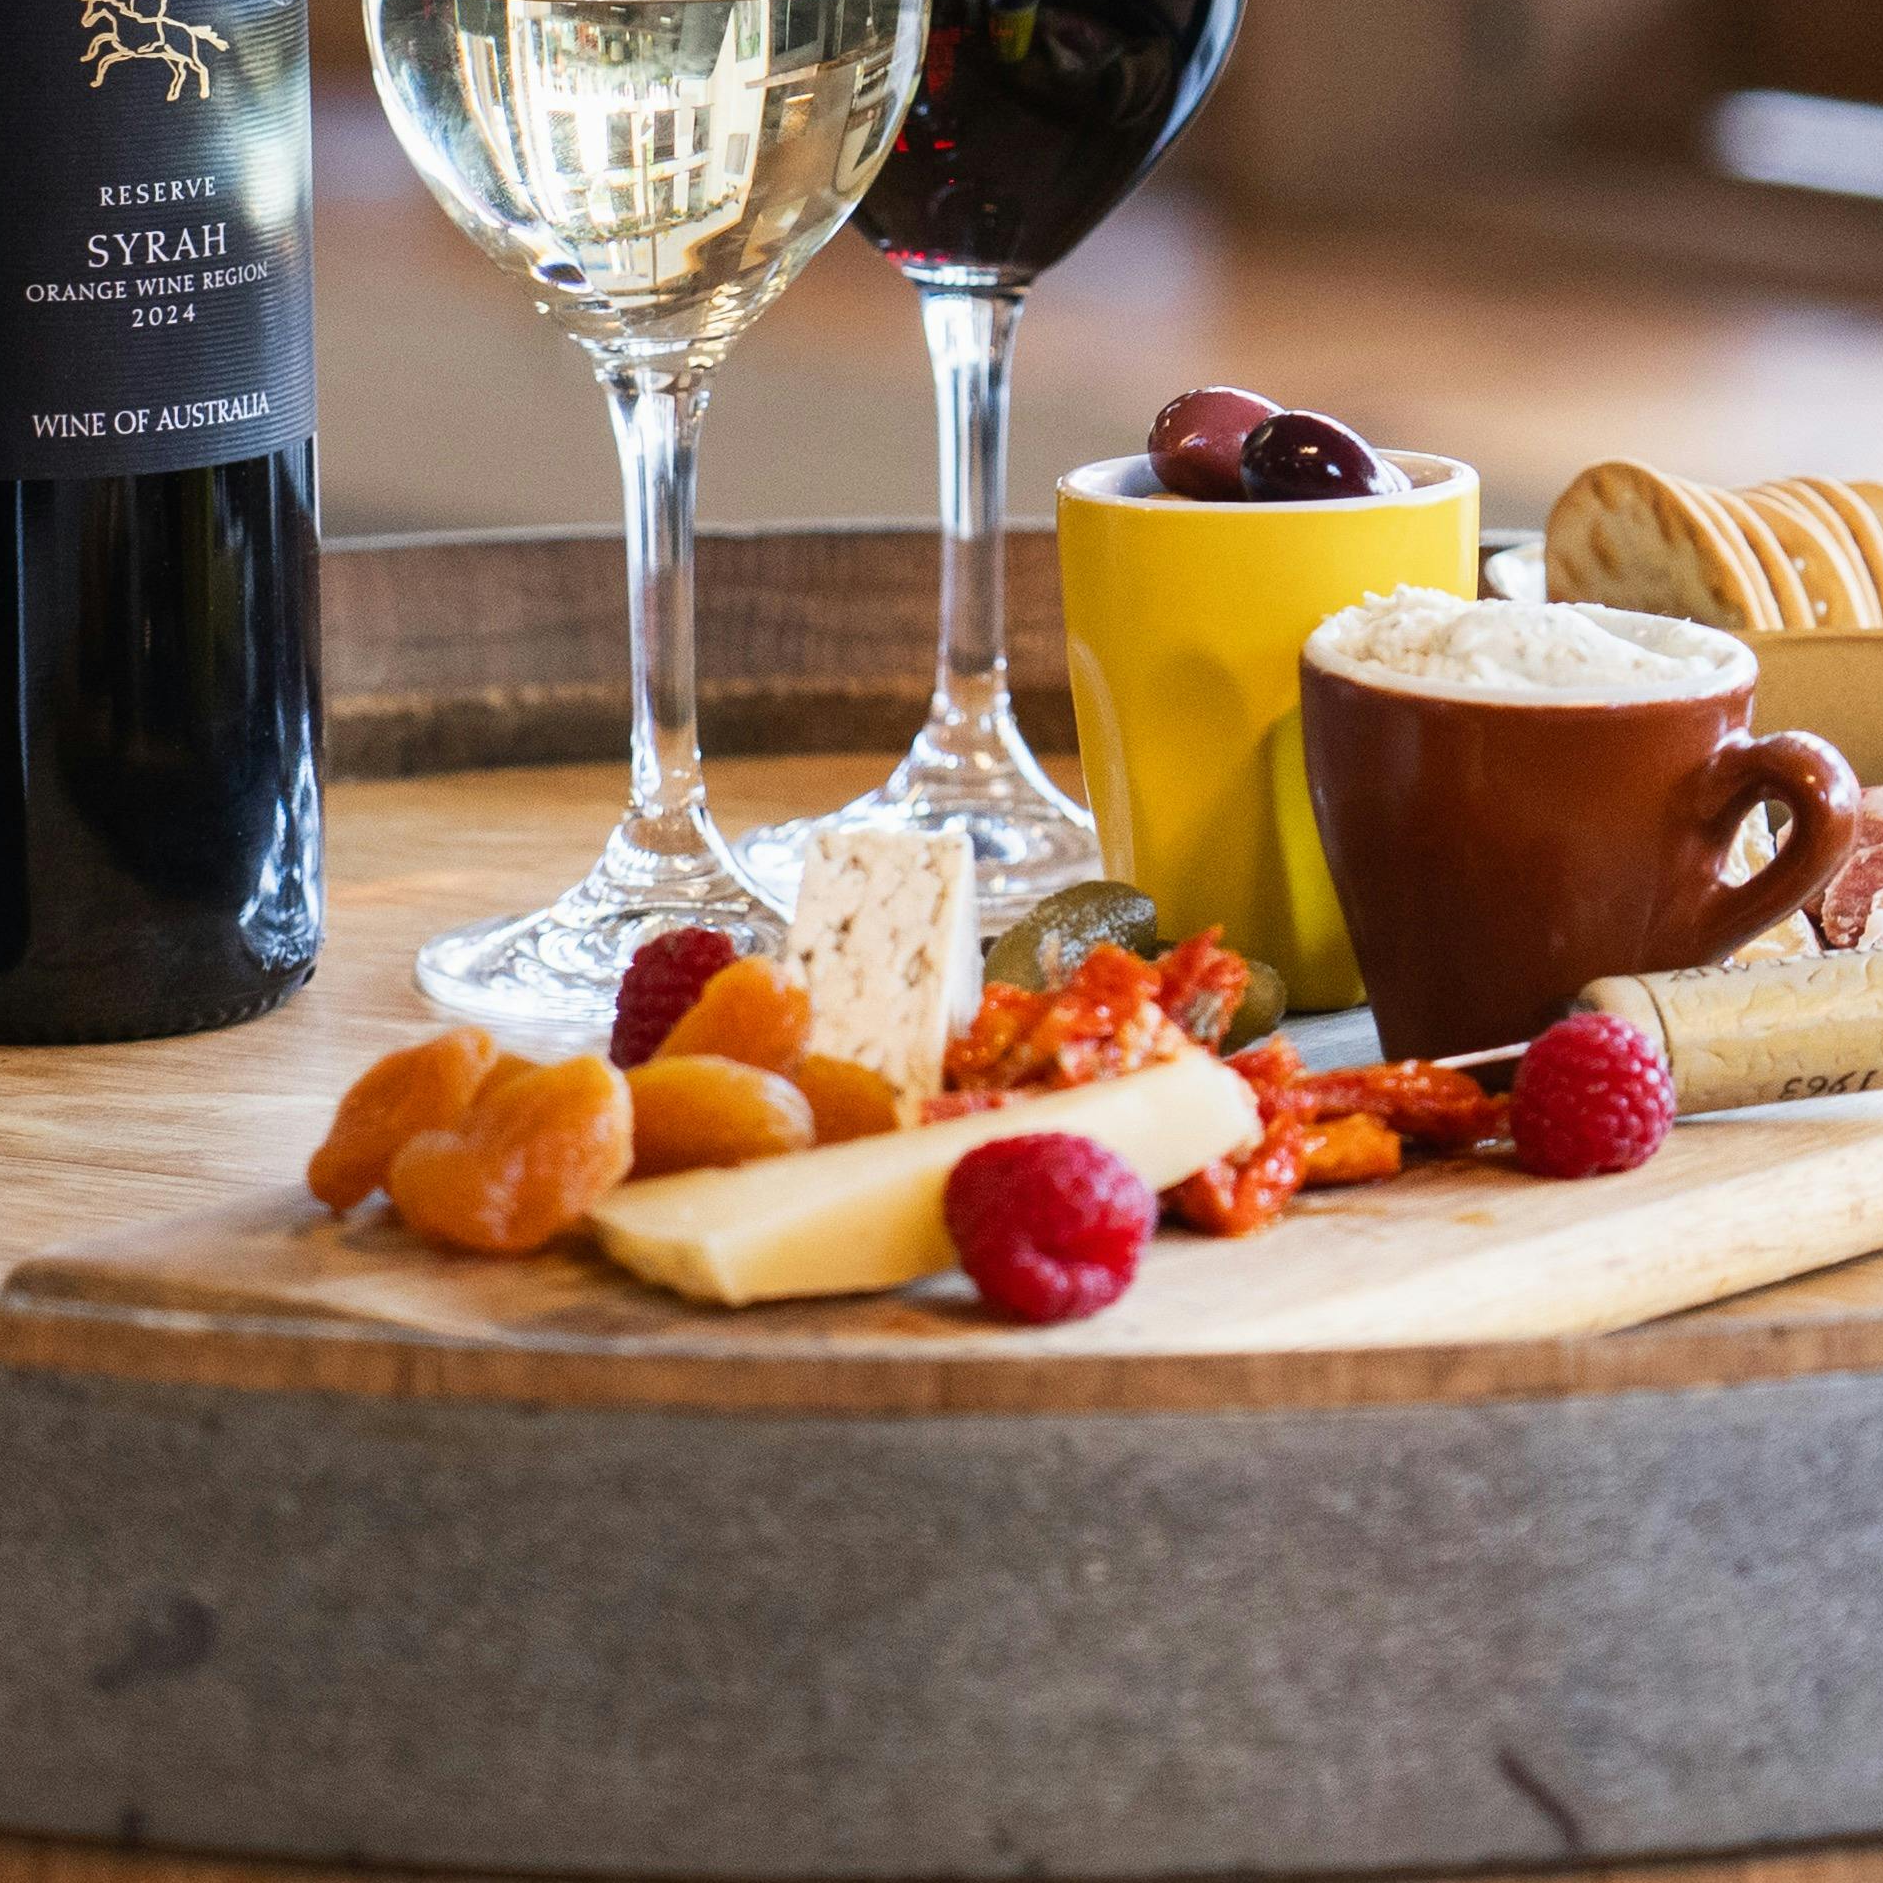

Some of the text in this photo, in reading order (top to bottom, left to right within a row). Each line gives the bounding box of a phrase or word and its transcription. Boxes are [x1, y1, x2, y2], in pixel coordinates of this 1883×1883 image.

[99, 175, 217, 207] RESERVE
[87, 221, 228, 269] SYRAH
[25, 260, 270, 303] ORANGE WINE REGION
[131, 303, 196, 328] 2024
[31, 391, 271, 438] WINE OF AUSTRALIA
